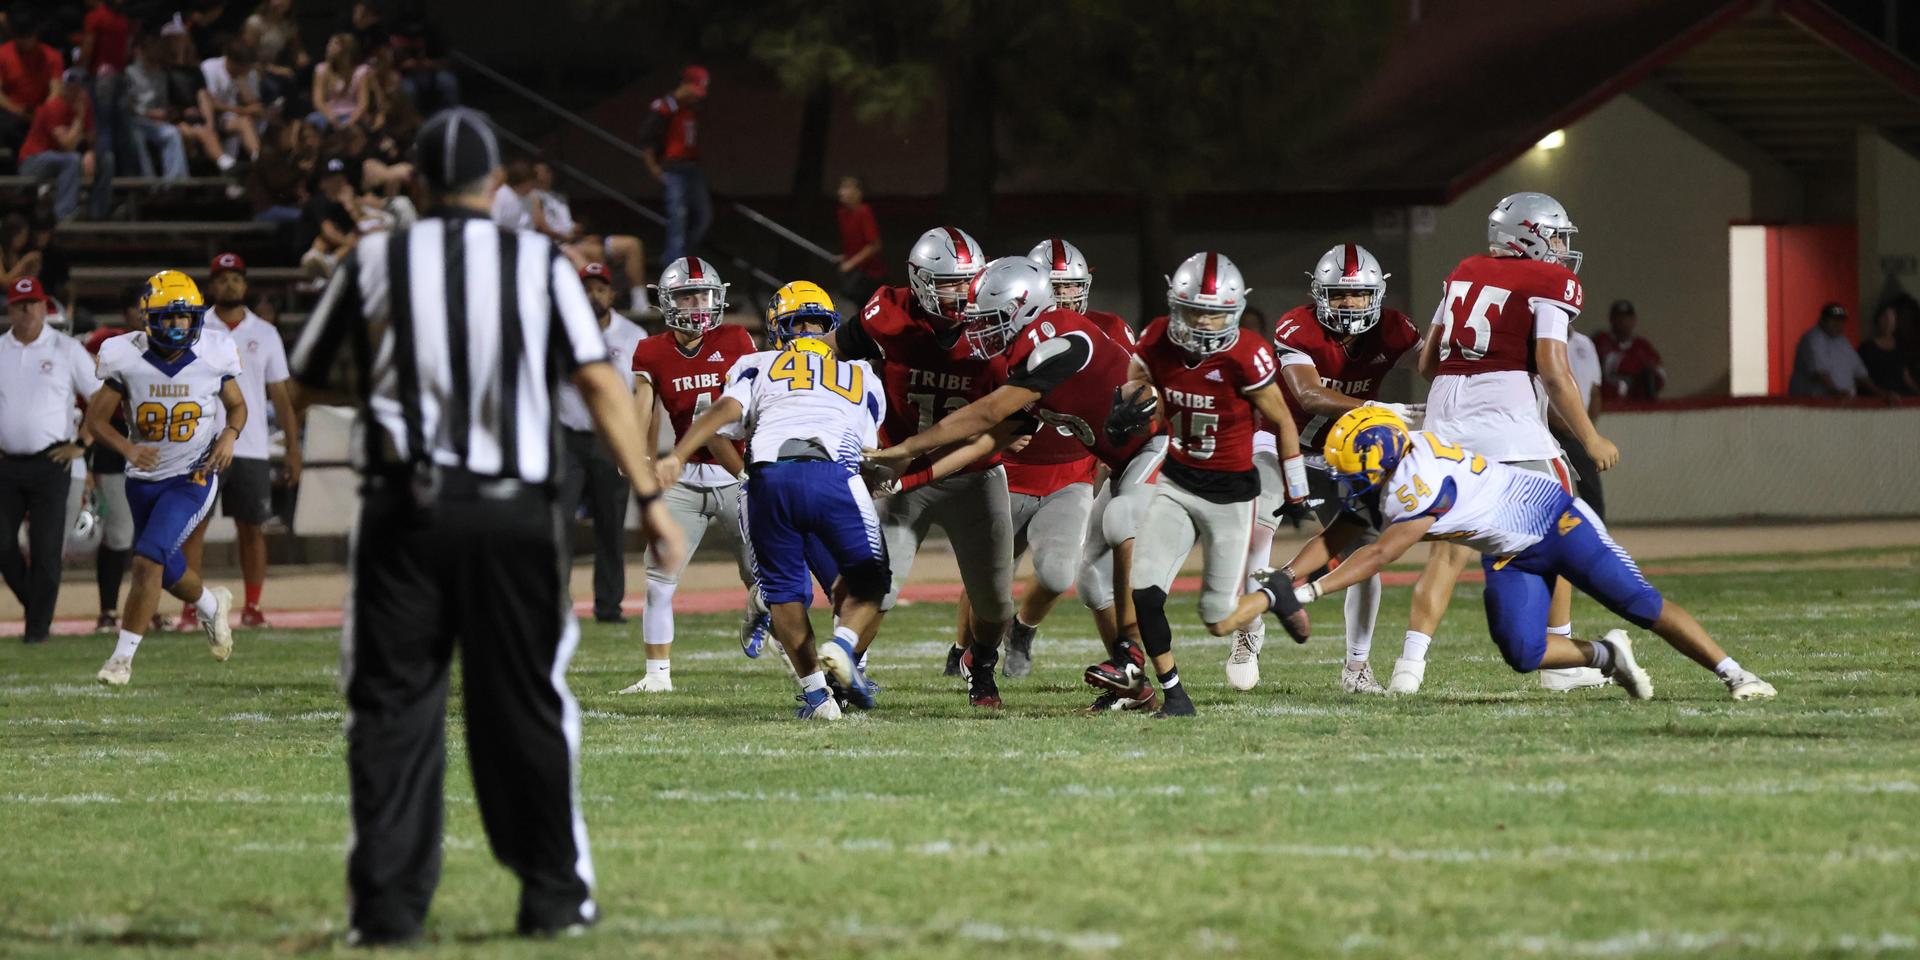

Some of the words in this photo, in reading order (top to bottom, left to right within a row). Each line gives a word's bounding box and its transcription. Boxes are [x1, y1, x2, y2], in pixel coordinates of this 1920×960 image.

[219, 253, 235, 267] C
[16, 279, 32, 292] C
[1253, 347, 1274, 378] 15
[672, 373, 721, 392] TRIBE
[768, 349, 863, 405] 40
[909, 368, 973, 391] TRIBE
[1320, 376, 1373, 395] TRIBE
[1164, 387, 1215, 409] TRIBE
[1170, 410, 1219, 460] 15
[1395, 474, 1432, 512] 54
